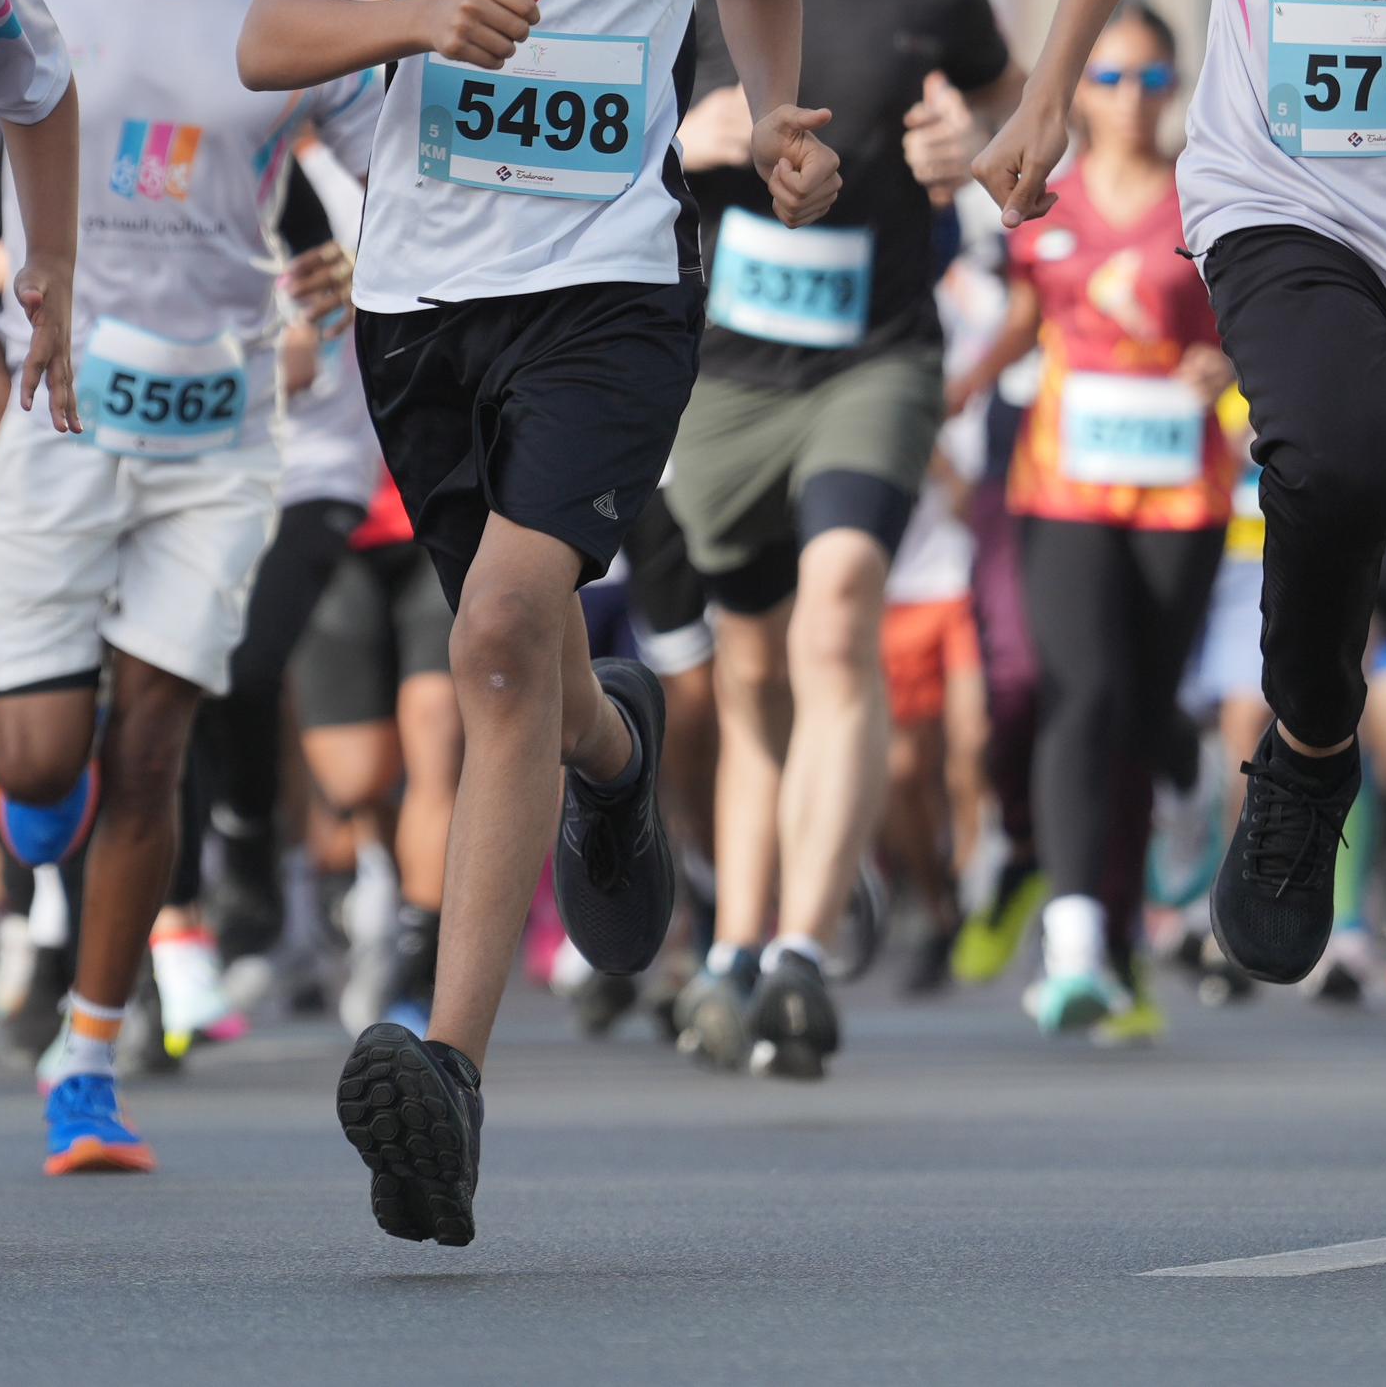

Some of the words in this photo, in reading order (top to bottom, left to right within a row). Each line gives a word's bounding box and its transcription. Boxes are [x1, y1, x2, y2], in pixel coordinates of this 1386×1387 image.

[1277, 102, 1288, 115] 5
[454, 79, 630, 155] 5498
[428, 124, 440, 138] 5
[1271, 123, 1297, 138] KM
[420, 143, 446, 161] KM
[102, 371, 239, 425] 5562
